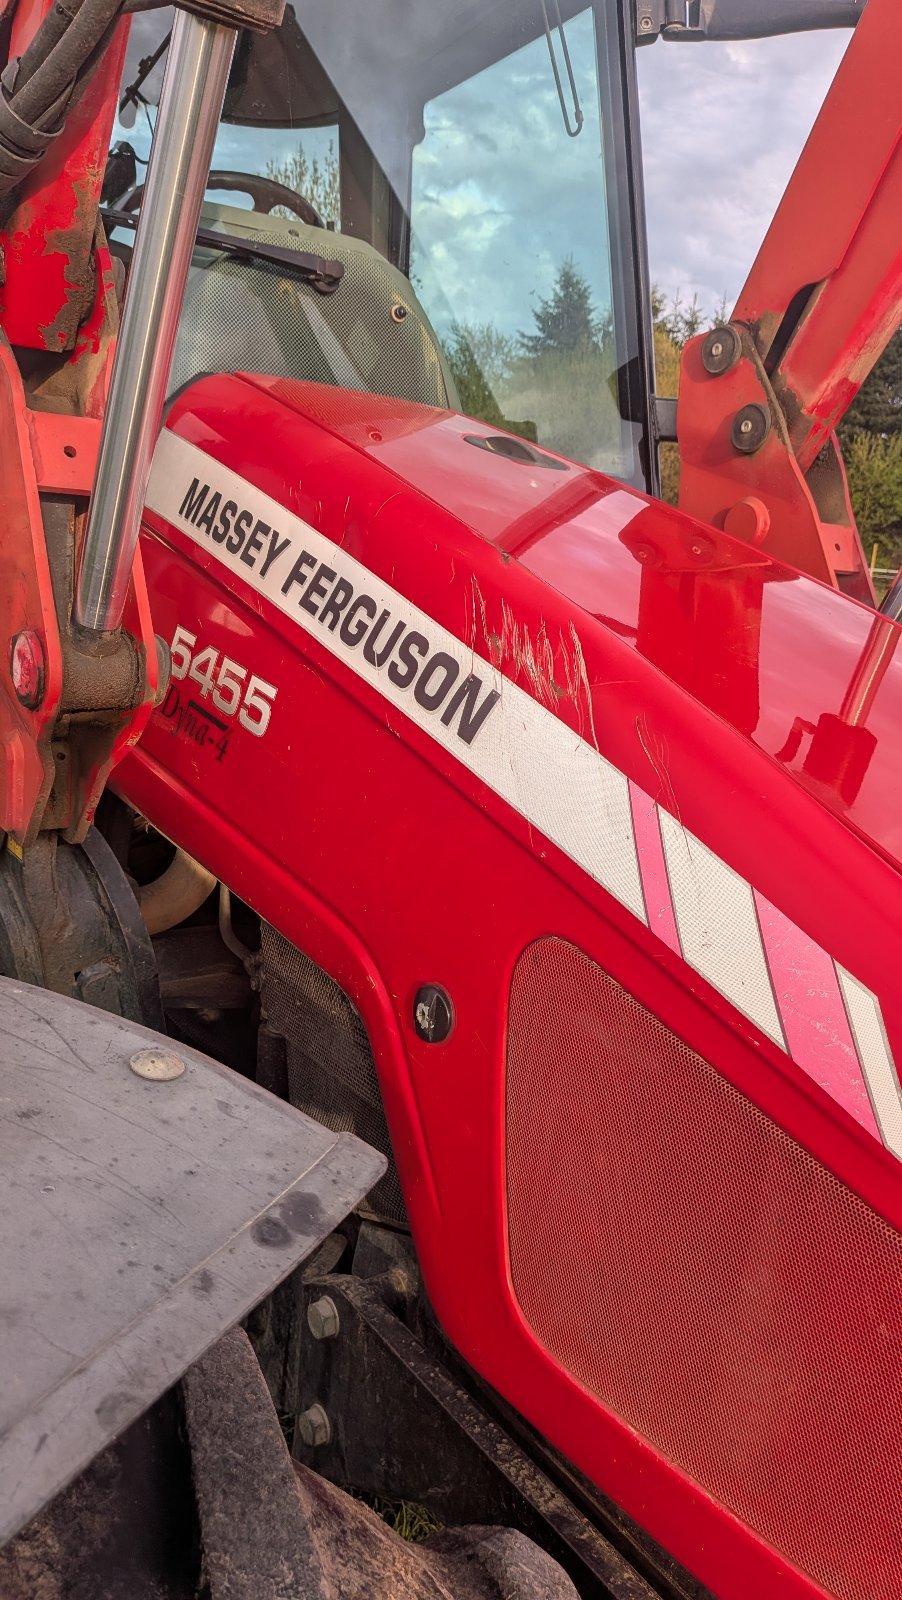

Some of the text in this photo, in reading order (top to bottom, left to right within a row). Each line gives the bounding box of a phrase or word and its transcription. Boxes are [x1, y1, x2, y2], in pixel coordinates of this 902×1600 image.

[178, 478, 501, 745] MASSEY FERGUSON
[161, 684, 234, 762] Dyna-4
[170, 624, 278, 737] 5455
